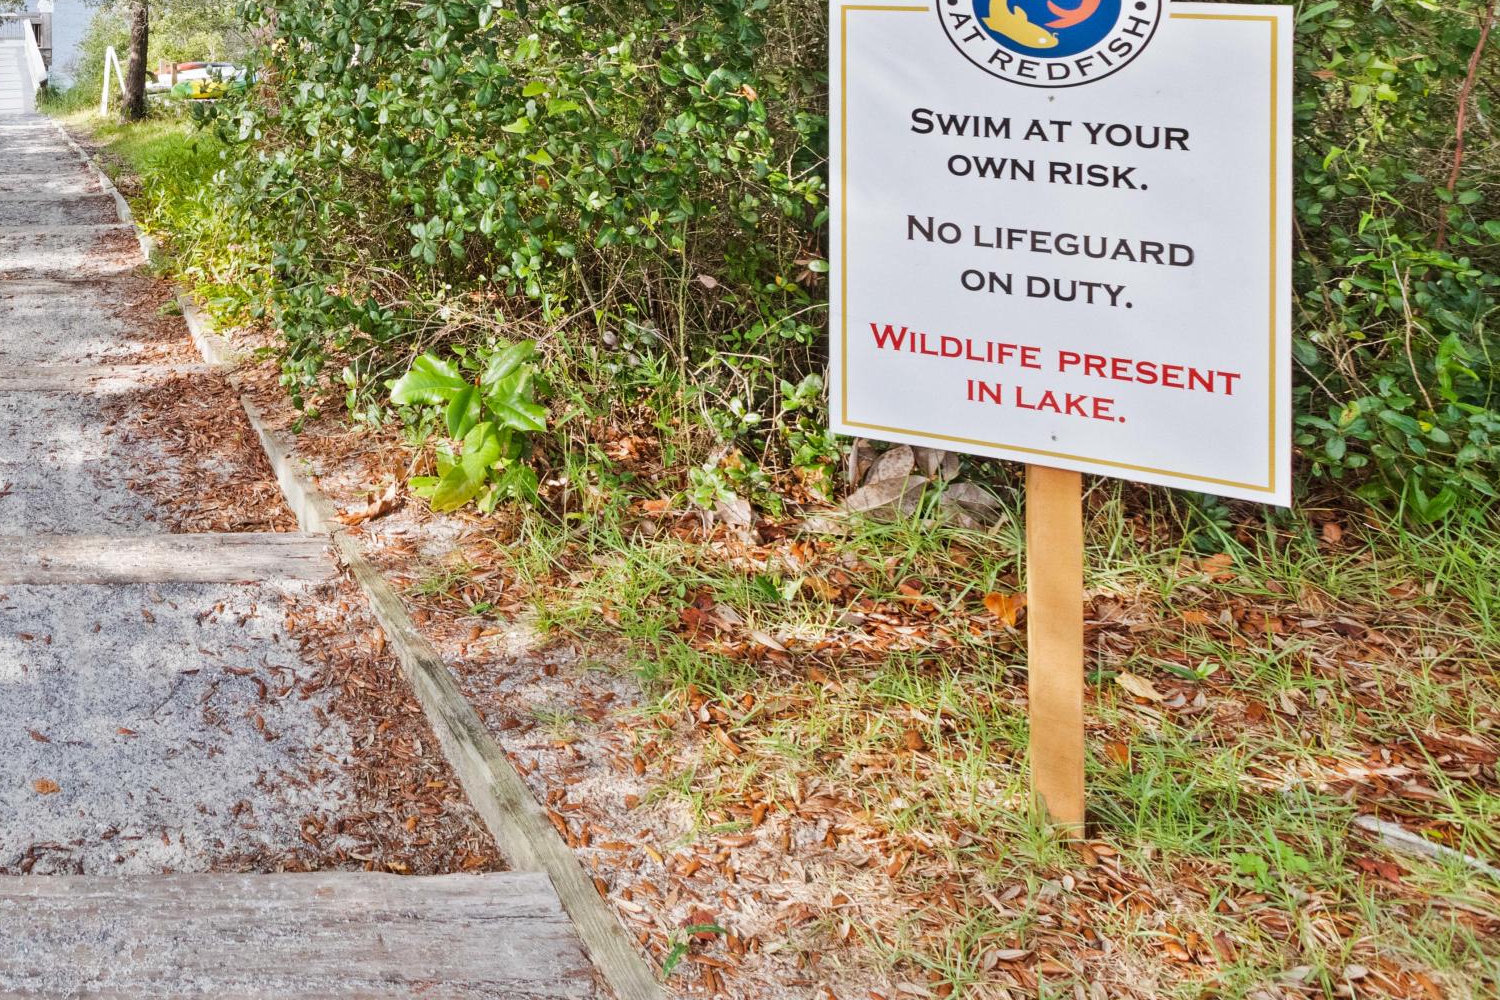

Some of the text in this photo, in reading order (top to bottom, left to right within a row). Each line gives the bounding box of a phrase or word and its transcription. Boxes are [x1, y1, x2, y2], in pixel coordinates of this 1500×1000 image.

[948, 11, 1151, 81] AT REDFISH
[910, 107, 1190, 152] SWIM AT YOUR
[947, 154, 1148, 191] OWN RISK.
[907, 214, 1195, 267] NO LIFEGUARD
[960, 269, 1133, 309] ON DUTY.
[869, 322, 1241, 396] WILDLIFE PRESENT
[967, 379, 1126, 424] IN LAKE.
